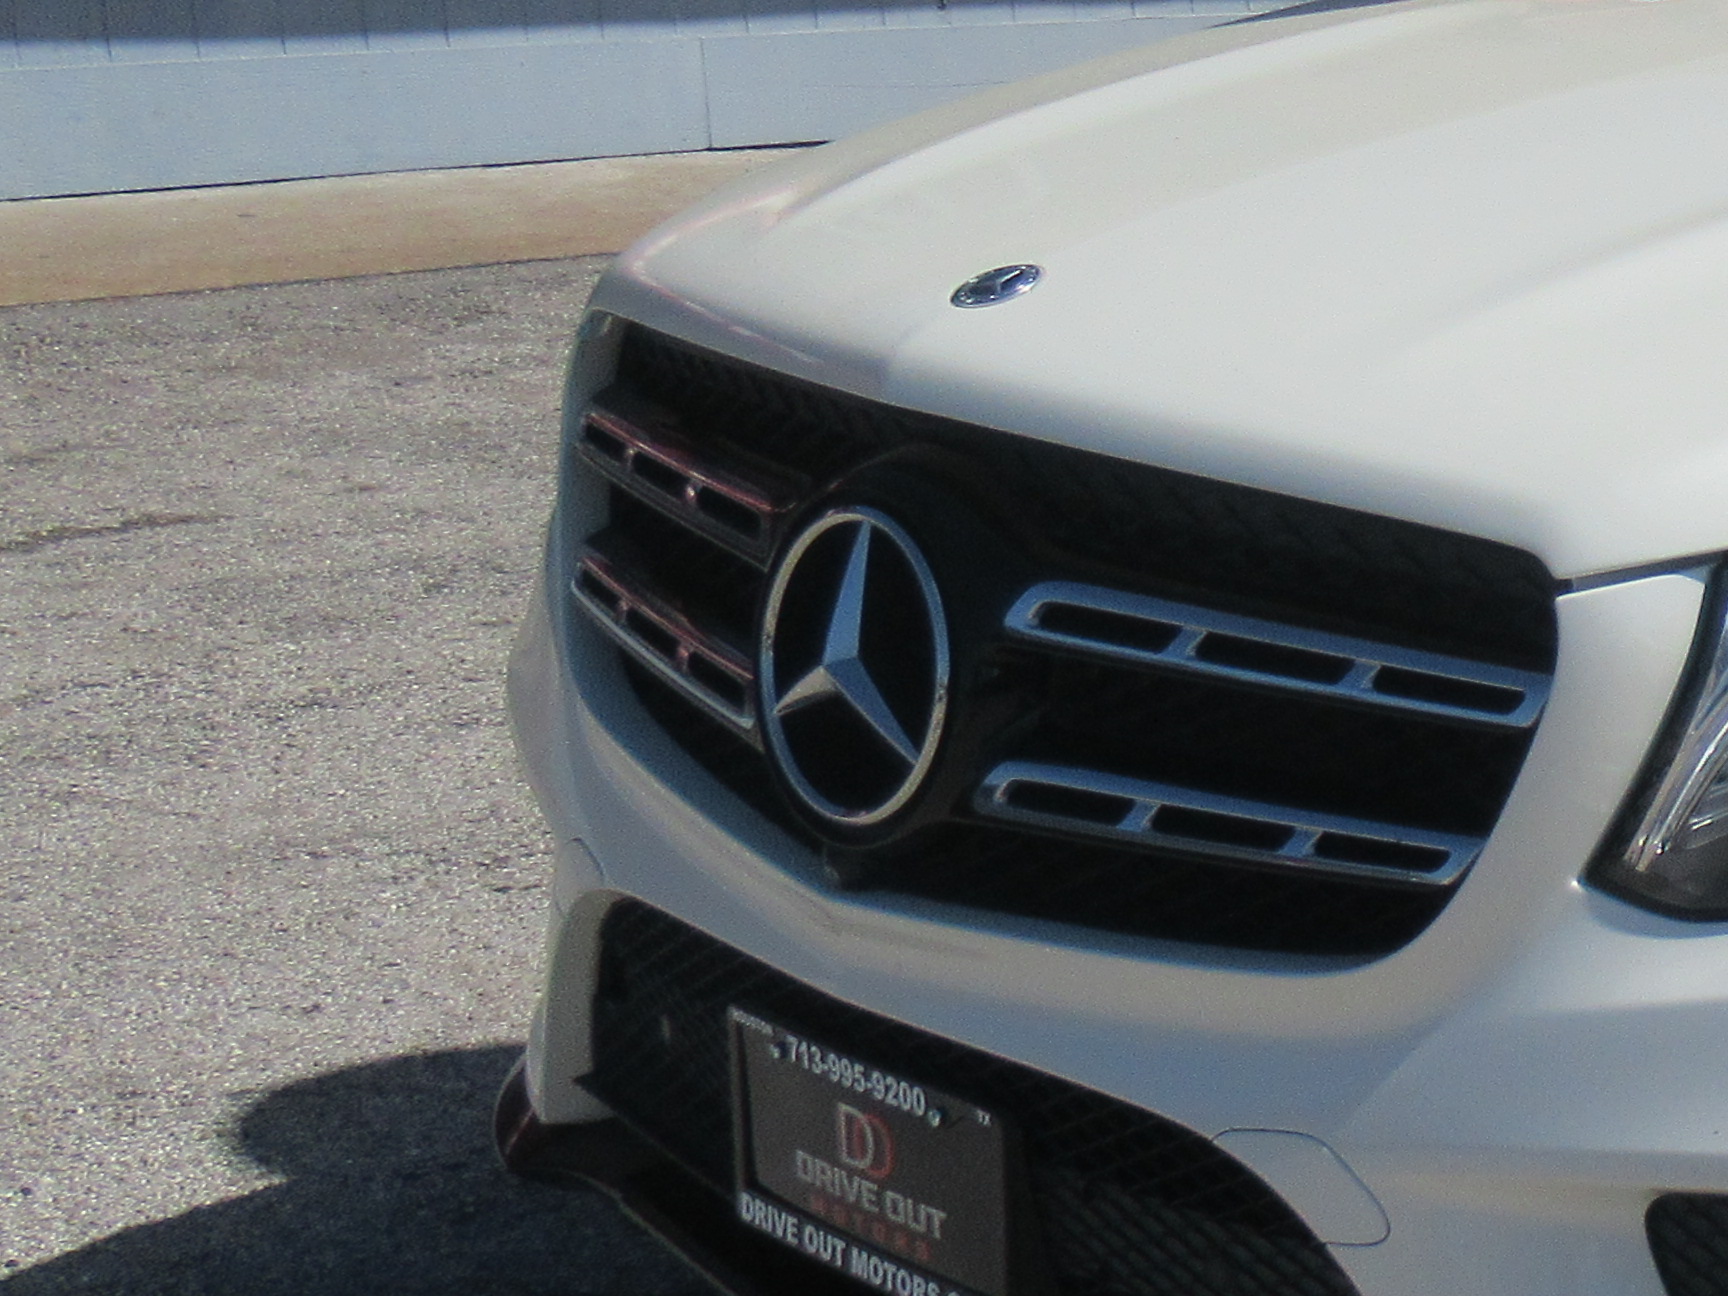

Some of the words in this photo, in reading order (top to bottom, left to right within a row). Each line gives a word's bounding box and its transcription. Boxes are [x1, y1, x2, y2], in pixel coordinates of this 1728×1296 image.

[784, 1034, 926, 1117] 713-995-9200
[740, 1191, 800, 1247] DRIVE
[804, 1225, 847, 1268] OUT
[795, 1150, 879, 1212] DRIVE
[884, 1189, 948, 1241] OUT
